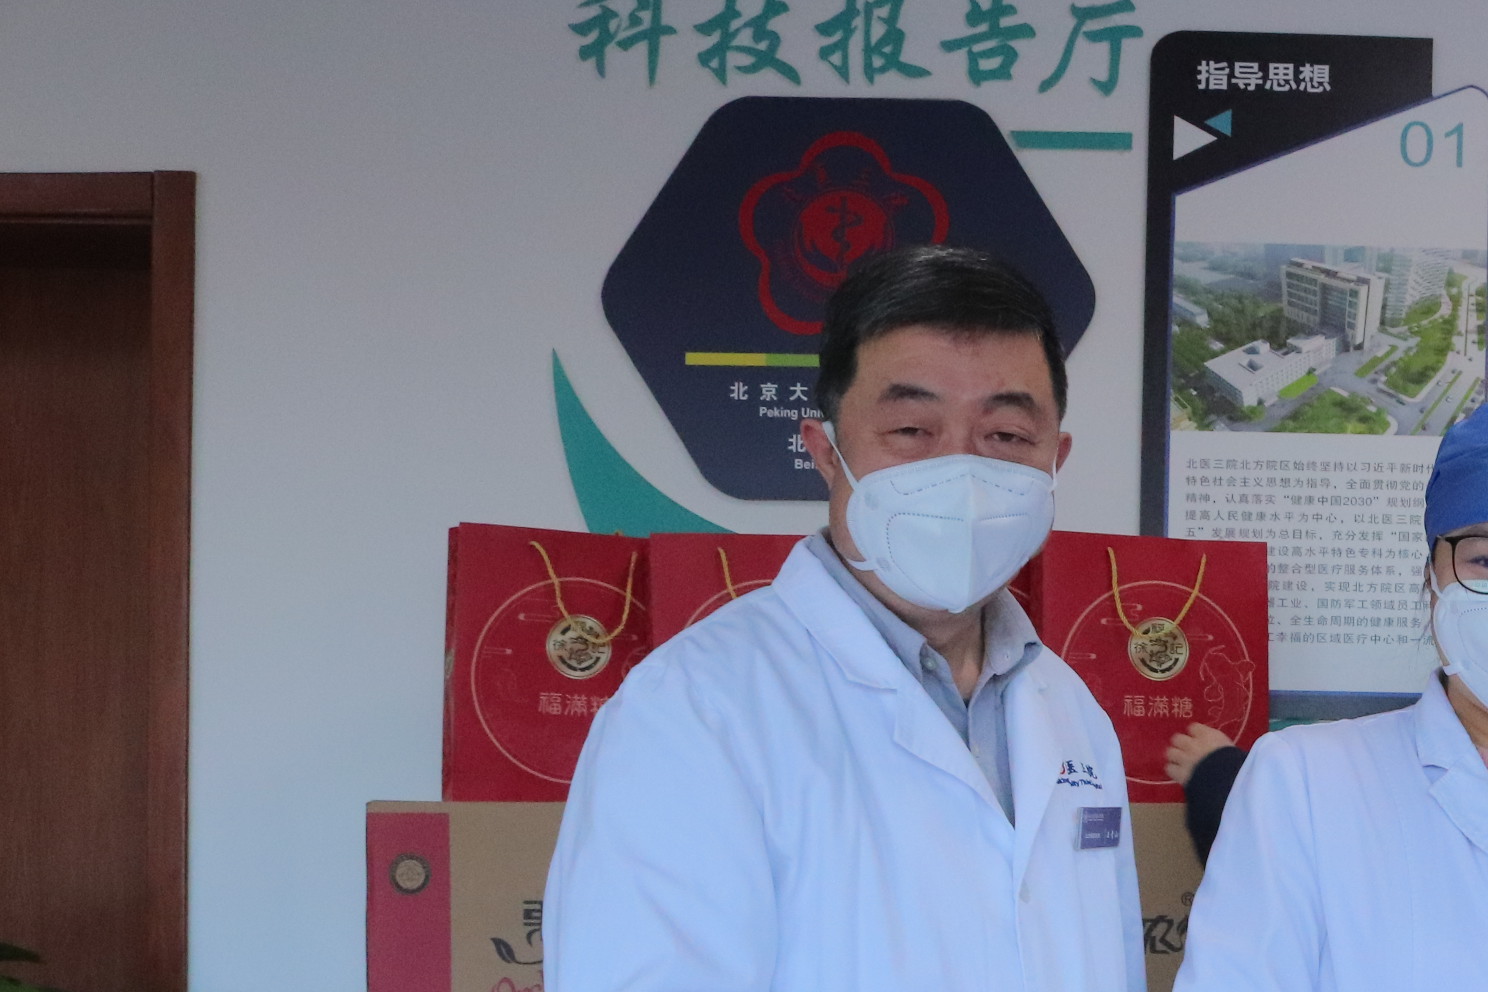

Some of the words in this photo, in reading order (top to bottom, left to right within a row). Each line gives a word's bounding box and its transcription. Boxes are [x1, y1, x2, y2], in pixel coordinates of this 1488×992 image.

[567, 0, 1145, 97] 科技报告厅
[1196, 60, 1331, 94] 指导思想
[1401, 120, 1465, 169] 01
[759, 406, 799, 420] Peking
[1123, 695, 1193, 718] 福滿糖
